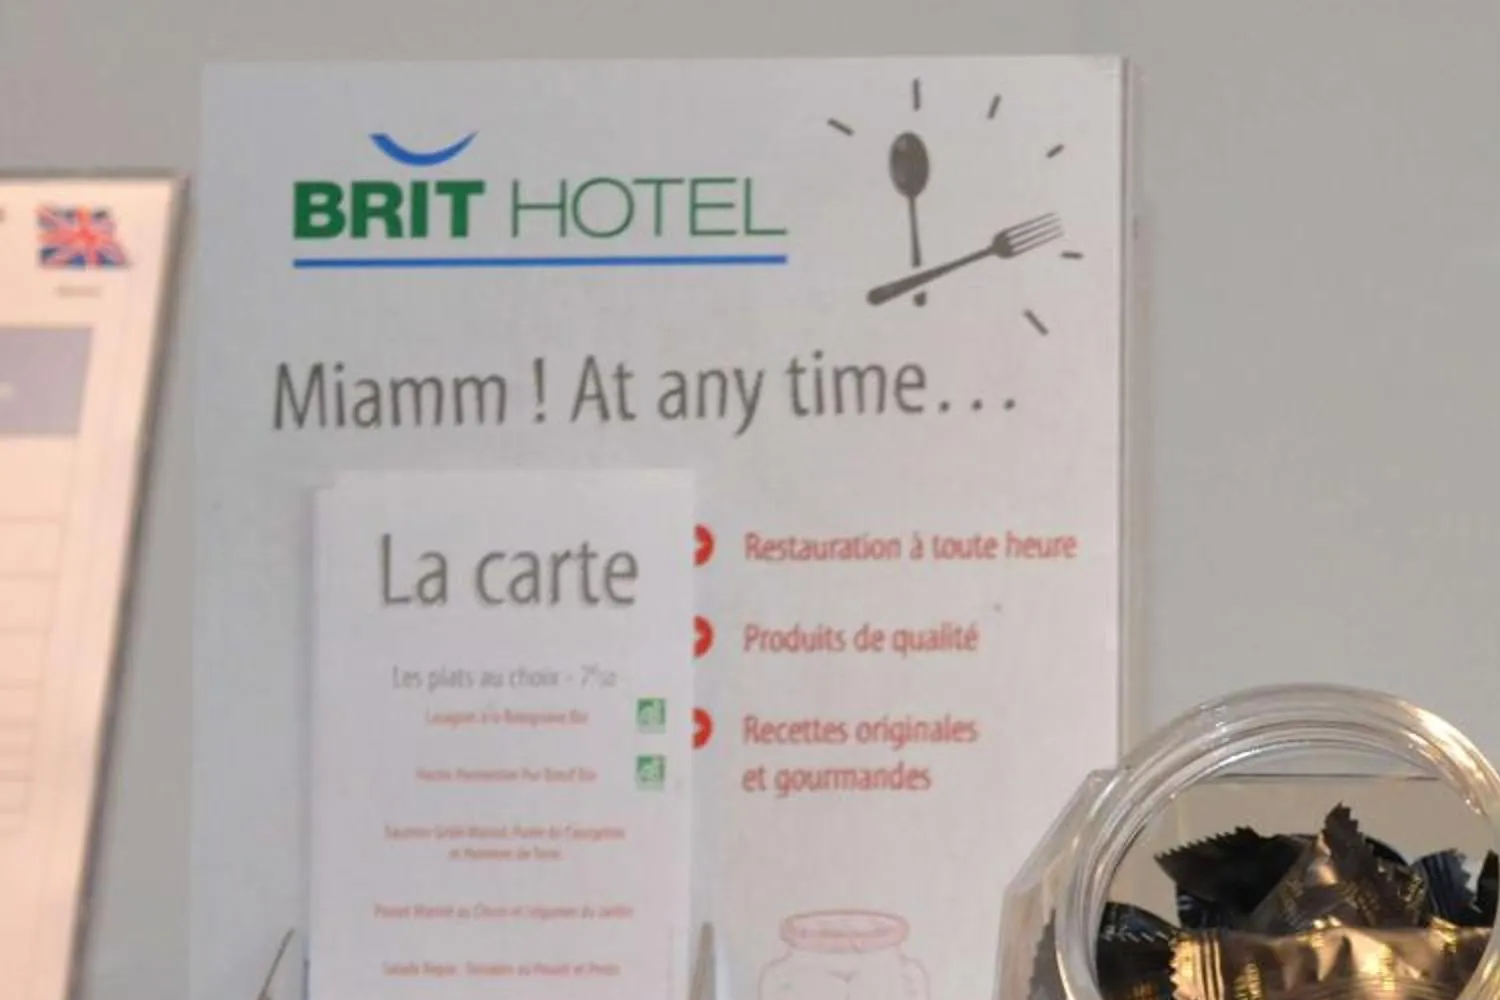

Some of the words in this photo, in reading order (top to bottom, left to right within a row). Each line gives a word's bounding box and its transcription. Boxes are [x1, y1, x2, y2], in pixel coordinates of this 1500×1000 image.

[293, 180, 486, 239] BRIT
[512, 177, 788, 238] HOTEL
[271, 361, 507, 430] Miamm
[571, 353, 636, 423] At
[658, 366, 765, 436] any
[744, 532, 900, 562] Restauration
[909, 531, 924, 560] à
[932, 533, 998, 560] toute
[1005, 531, 1078, 559] heure
[380, 532, 448, 605] La
[475, 540, 639, 605] carte
[743, 624, 847, 654] Produits
[853, 623, 885, 652] de
[892, 621, 979, 658] qualité
[742, 715, 848, 745] Recettes
[855, 715, 978, 750] originales
[742, 766, 766, 793] et
[774, 763, 932, 798] gourmandes
